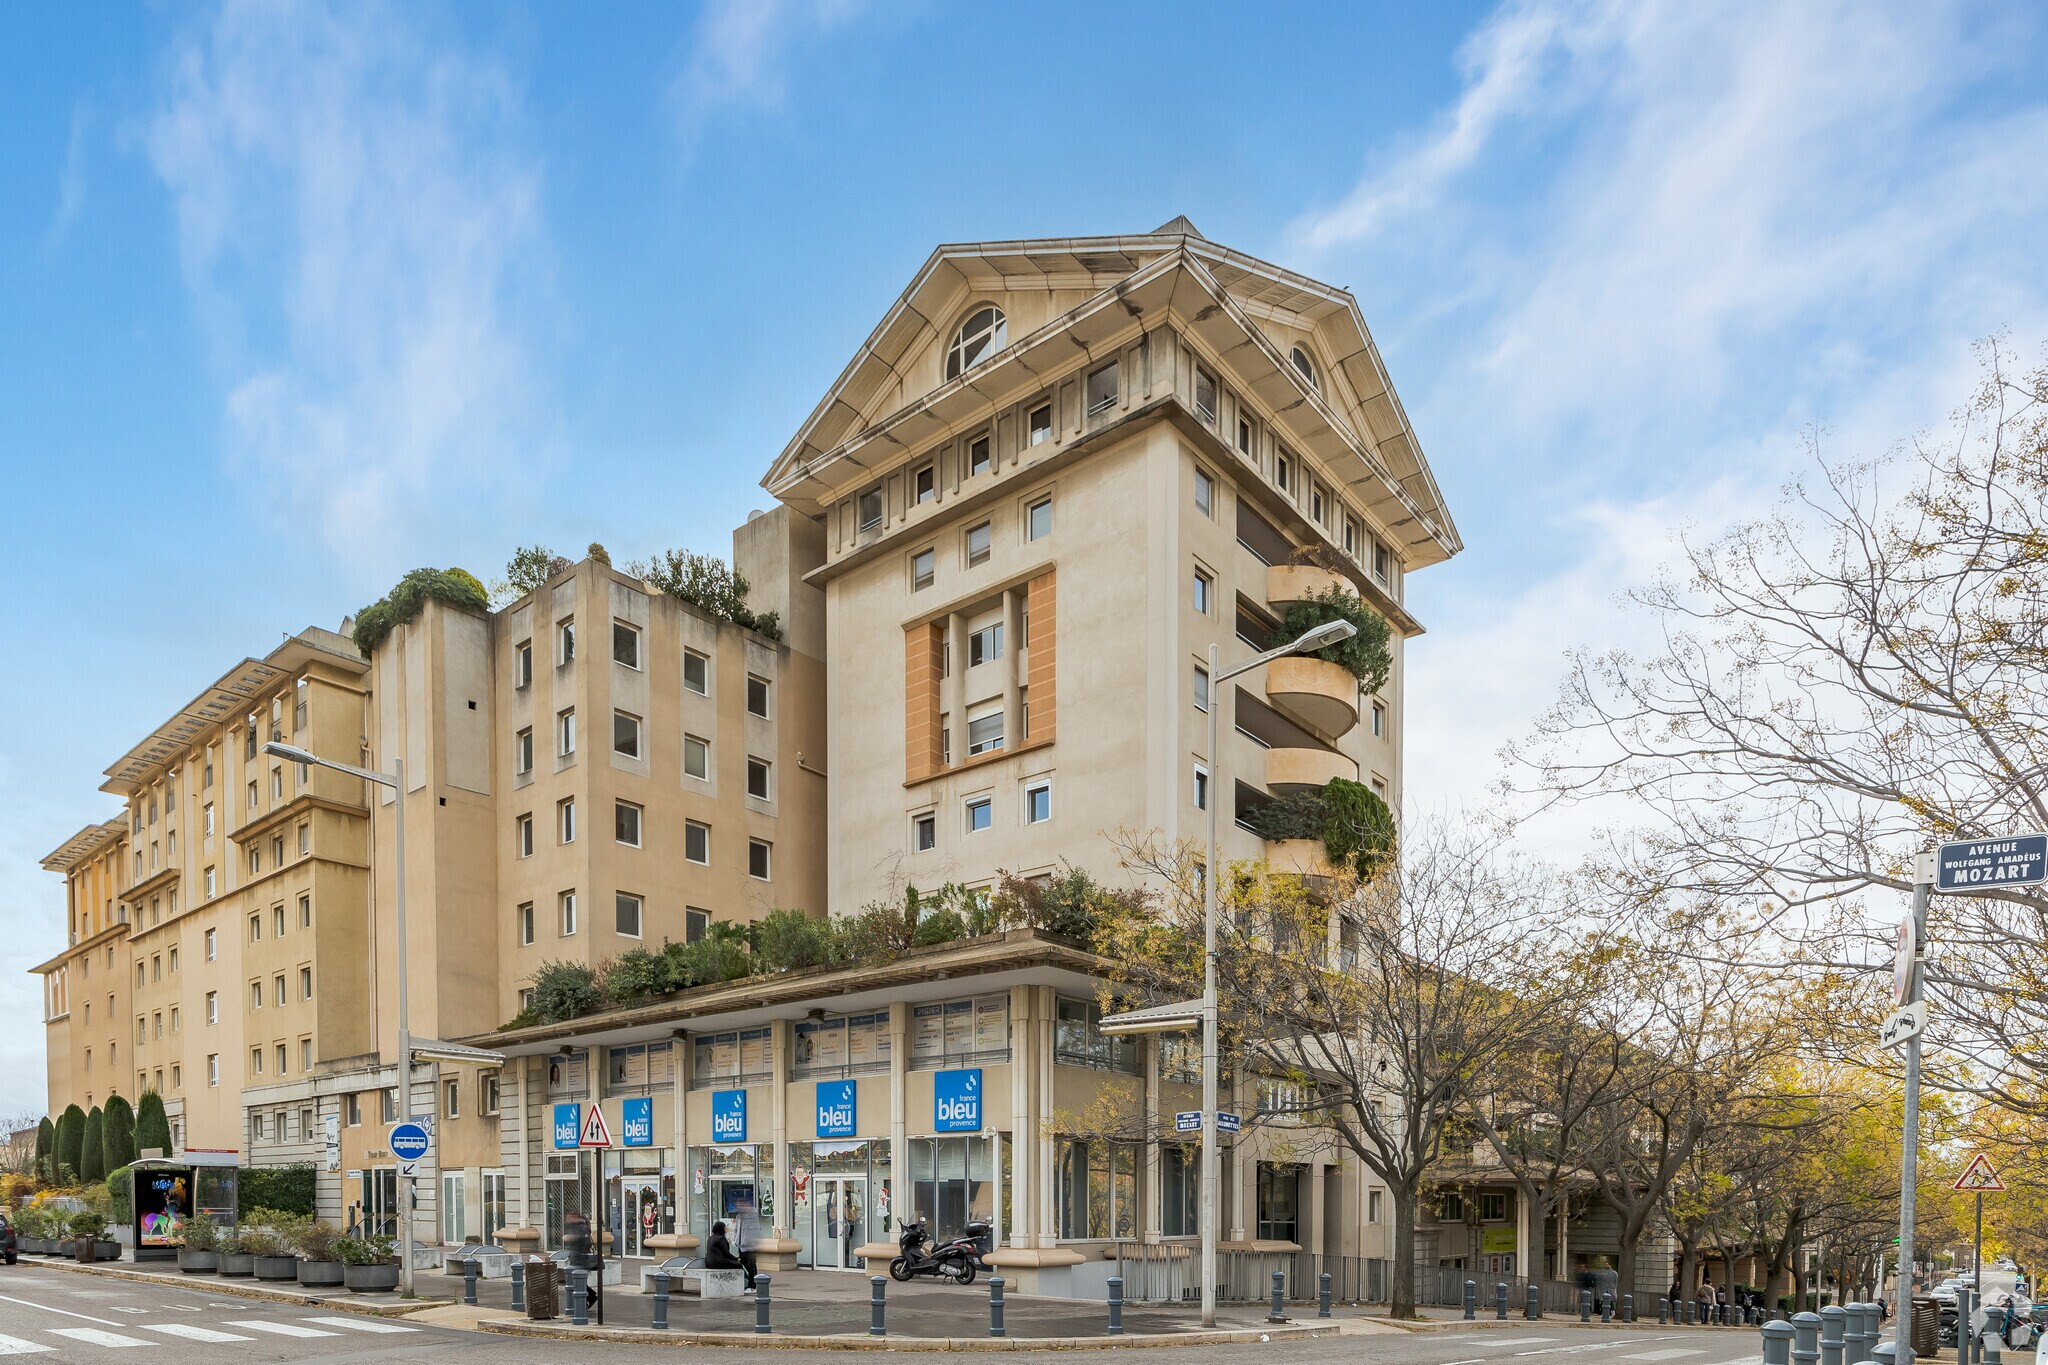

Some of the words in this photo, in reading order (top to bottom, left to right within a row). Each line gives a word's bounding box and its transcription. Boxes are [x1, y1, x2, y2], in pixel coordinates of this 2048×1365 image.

[1969, 842, 2017, 856] AVENUE
[1945, 858, 1991, 869] WOLFGANG
[1998, 852, 2041, 864] AMADÉUS
[1954, 863, 2030, 884] MOZART
[917, 1006, 940, 1016] PIGIER
[819, 1106, 852, 1127] bleu
[938, 1098, 977, 1121] bleu
[556, 1123, 577, 1140] bleu
[625, 1119, 648, 1137] bleu
[715, 1114, 742, 1133] bleu
[829, 1126, 852, 1134] provence
[949, 1120, 977, 1128] provence
[107, 1302, 248, 1314] BUS
